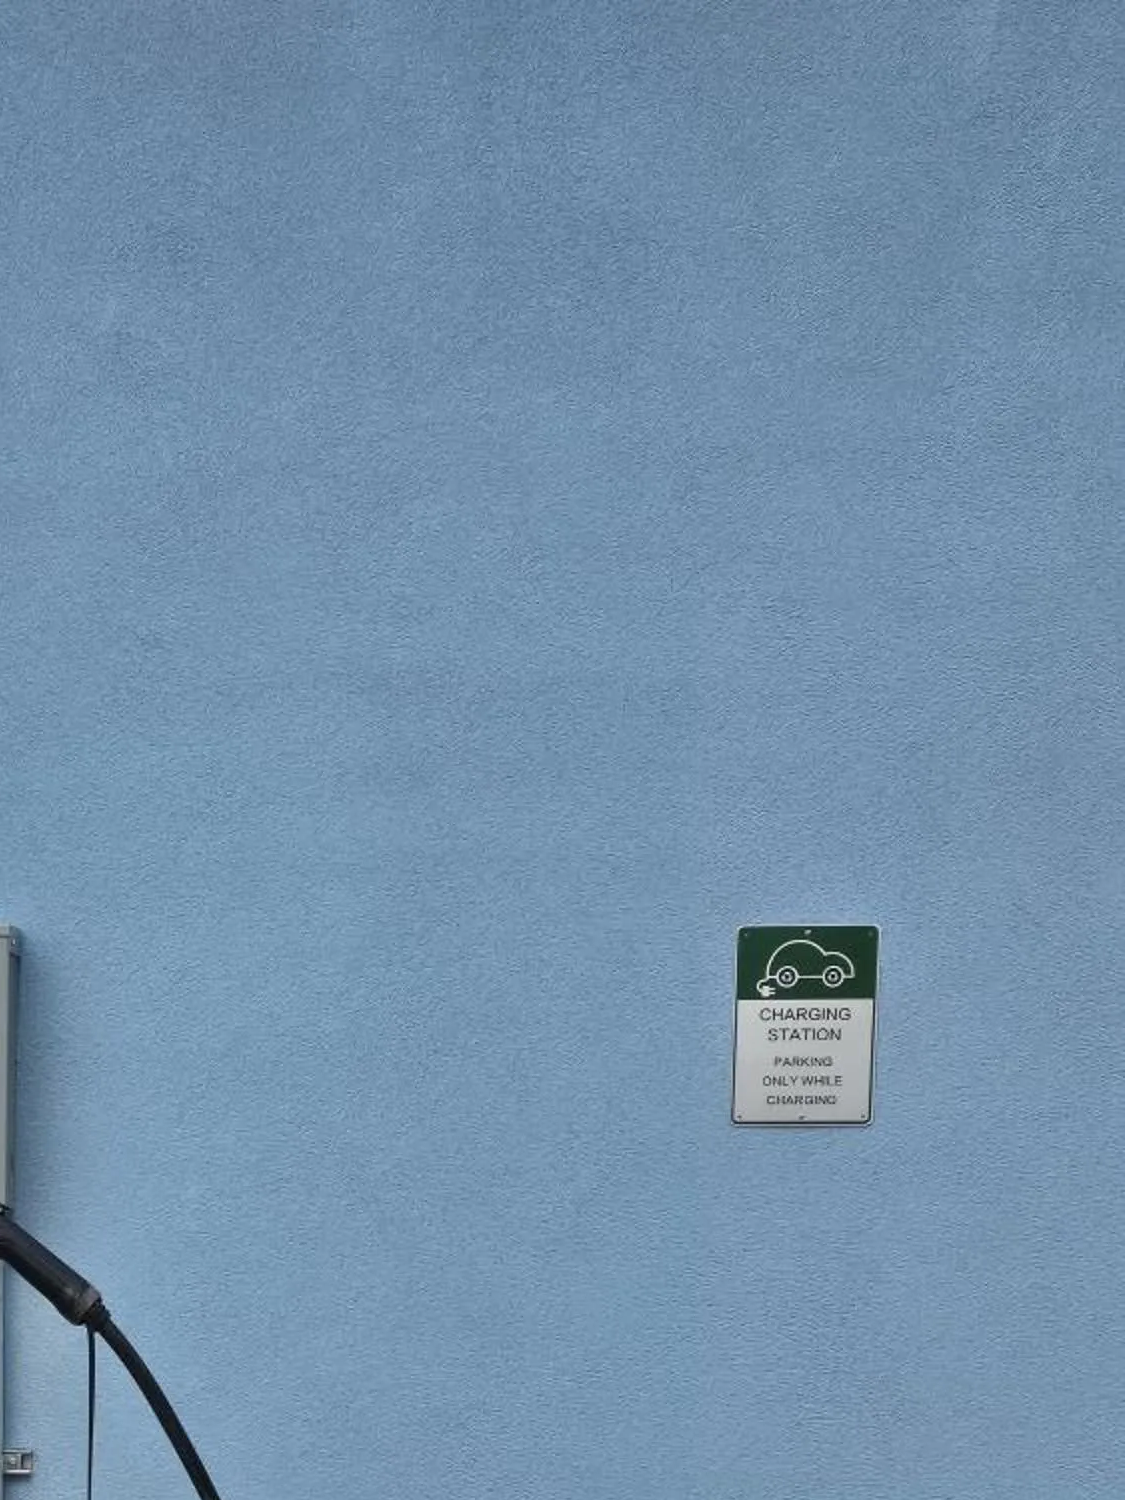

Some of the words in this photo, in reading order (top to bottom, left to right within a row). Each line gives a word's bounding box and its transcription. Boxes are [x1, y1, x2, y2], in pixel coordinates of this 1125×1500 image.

[759, 1007, 852, 1021] CHARGING
[767, 1027, 842, 1041] STATION
[774, 1056, 834, 1067] PARKING
[762, 1075, 798, 1087] ONLY
[801, 1075, 843, 1087] WHILE
[766, 1095, 837, 1105] CHARGING
